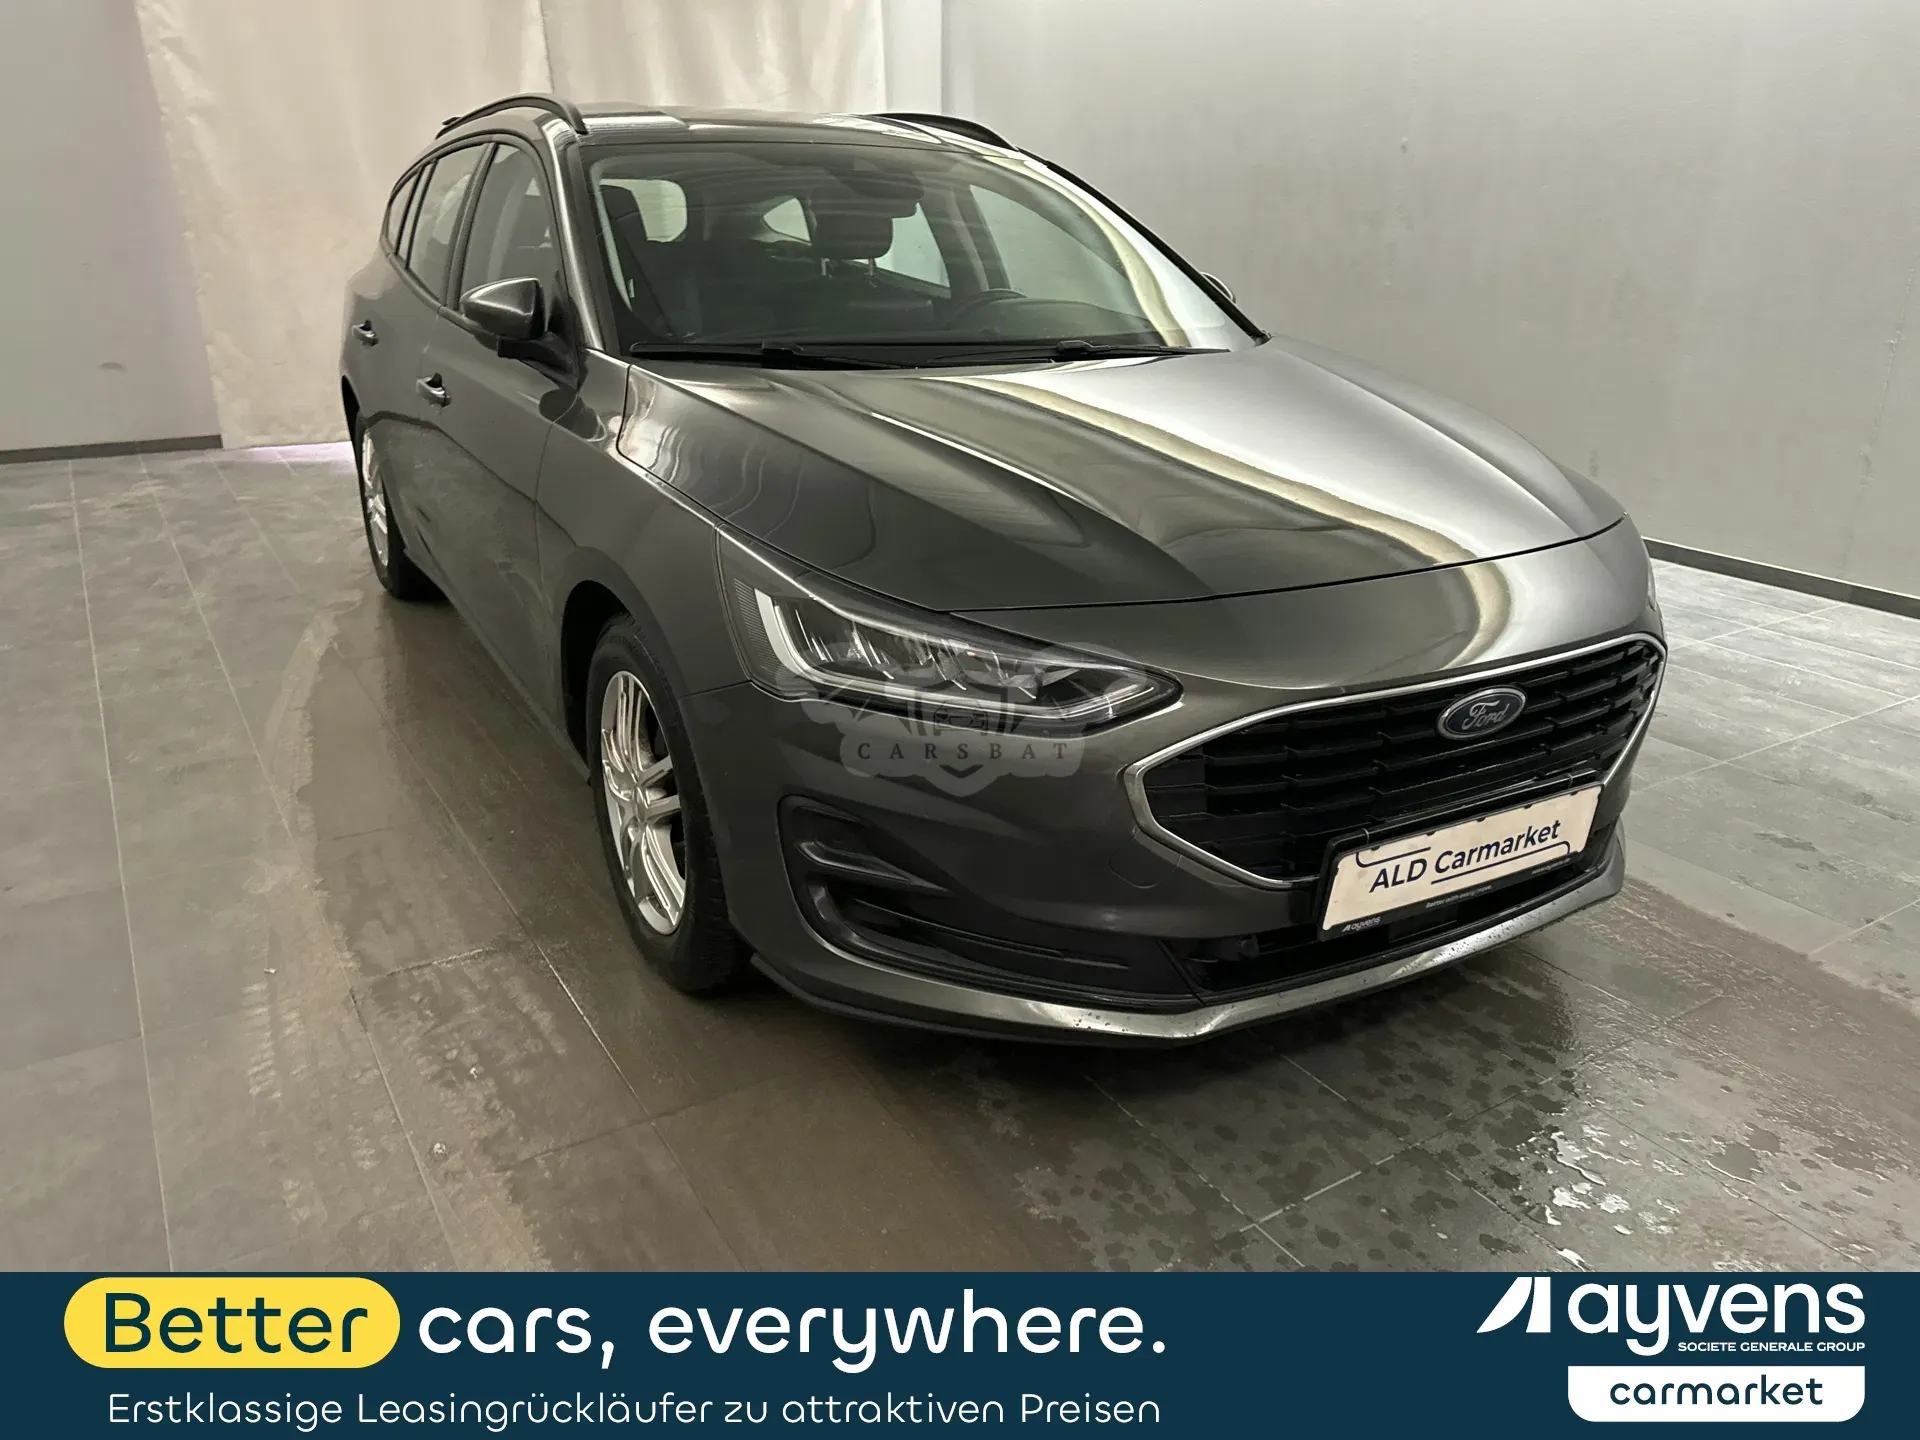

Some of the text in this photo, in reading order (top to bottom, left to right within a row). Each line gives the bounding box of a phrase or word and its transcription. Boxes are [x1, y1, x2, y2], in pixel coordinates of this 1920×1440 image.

[1461, 700, 1510, 730] Ford
[1369, 820, 1561, 893] ALD Carmarket
